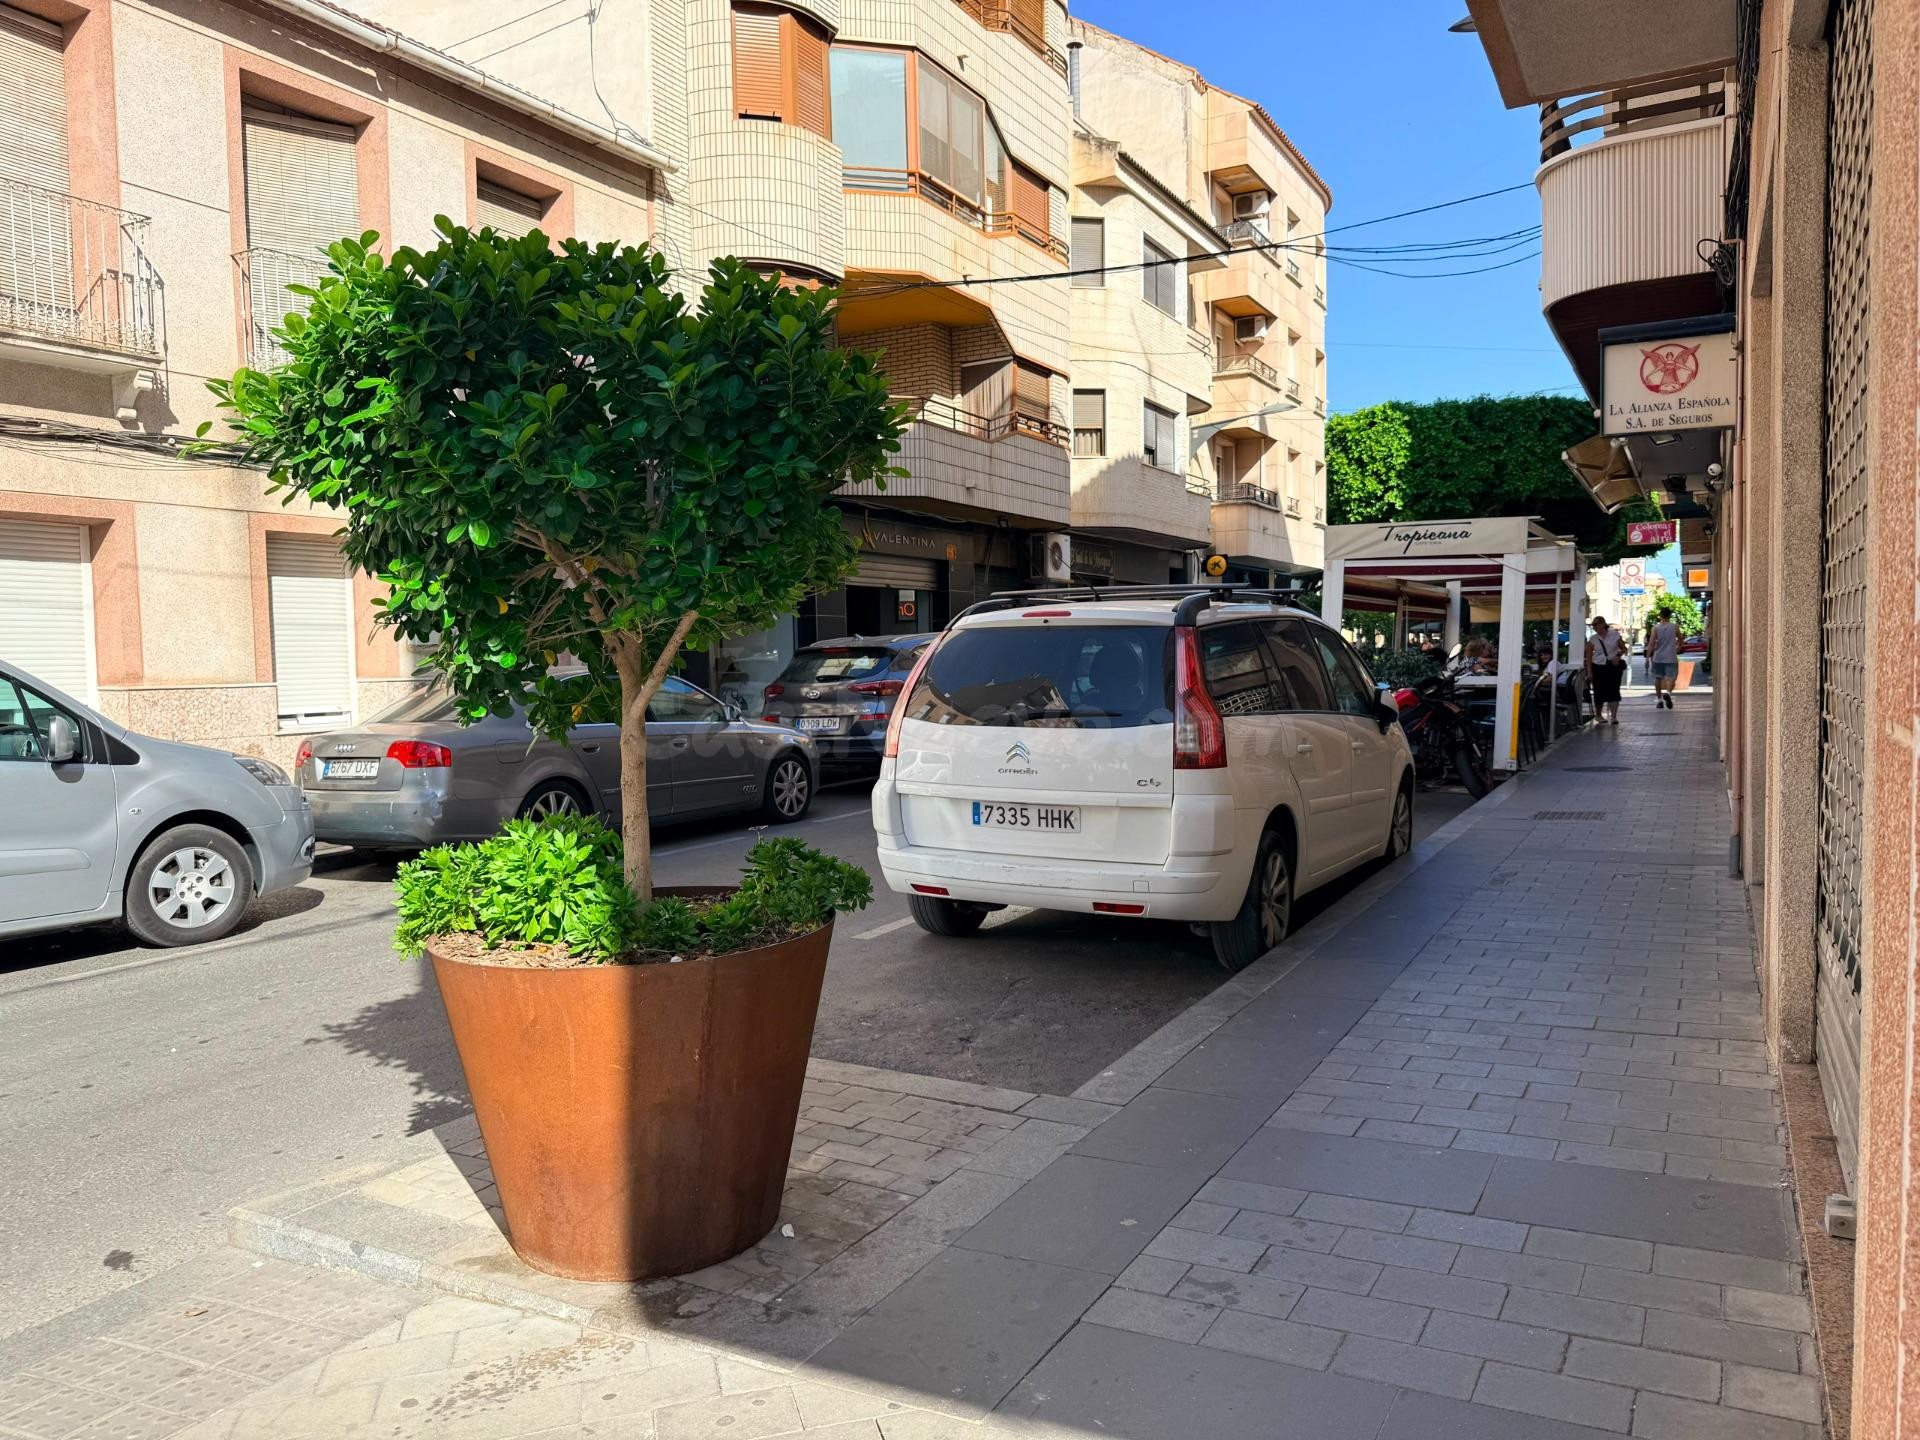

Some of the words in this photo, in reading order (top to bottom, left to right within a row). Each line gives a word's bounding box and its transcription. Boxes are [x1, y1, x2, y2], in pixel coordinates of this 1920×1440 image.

[1609, 404, 1624, 416] LA
[1630, 402, 1673, 415] ALIANZA
[1678, 395, 1731, 410] ESPAÑOLA
[1625, 418, 1647, 430] S.A.
[873, 531, 936, 549] VALENTINA
[1378, 521, 1473, 555] Tropicana
[800, 719, 820, 728] 0309
[330, 761, 353, 773] 6767
[355, 761, 377, 773] DXF
[984, 805, 1031, 827] 7335
[1037, 808, 1075, 829] HHK
